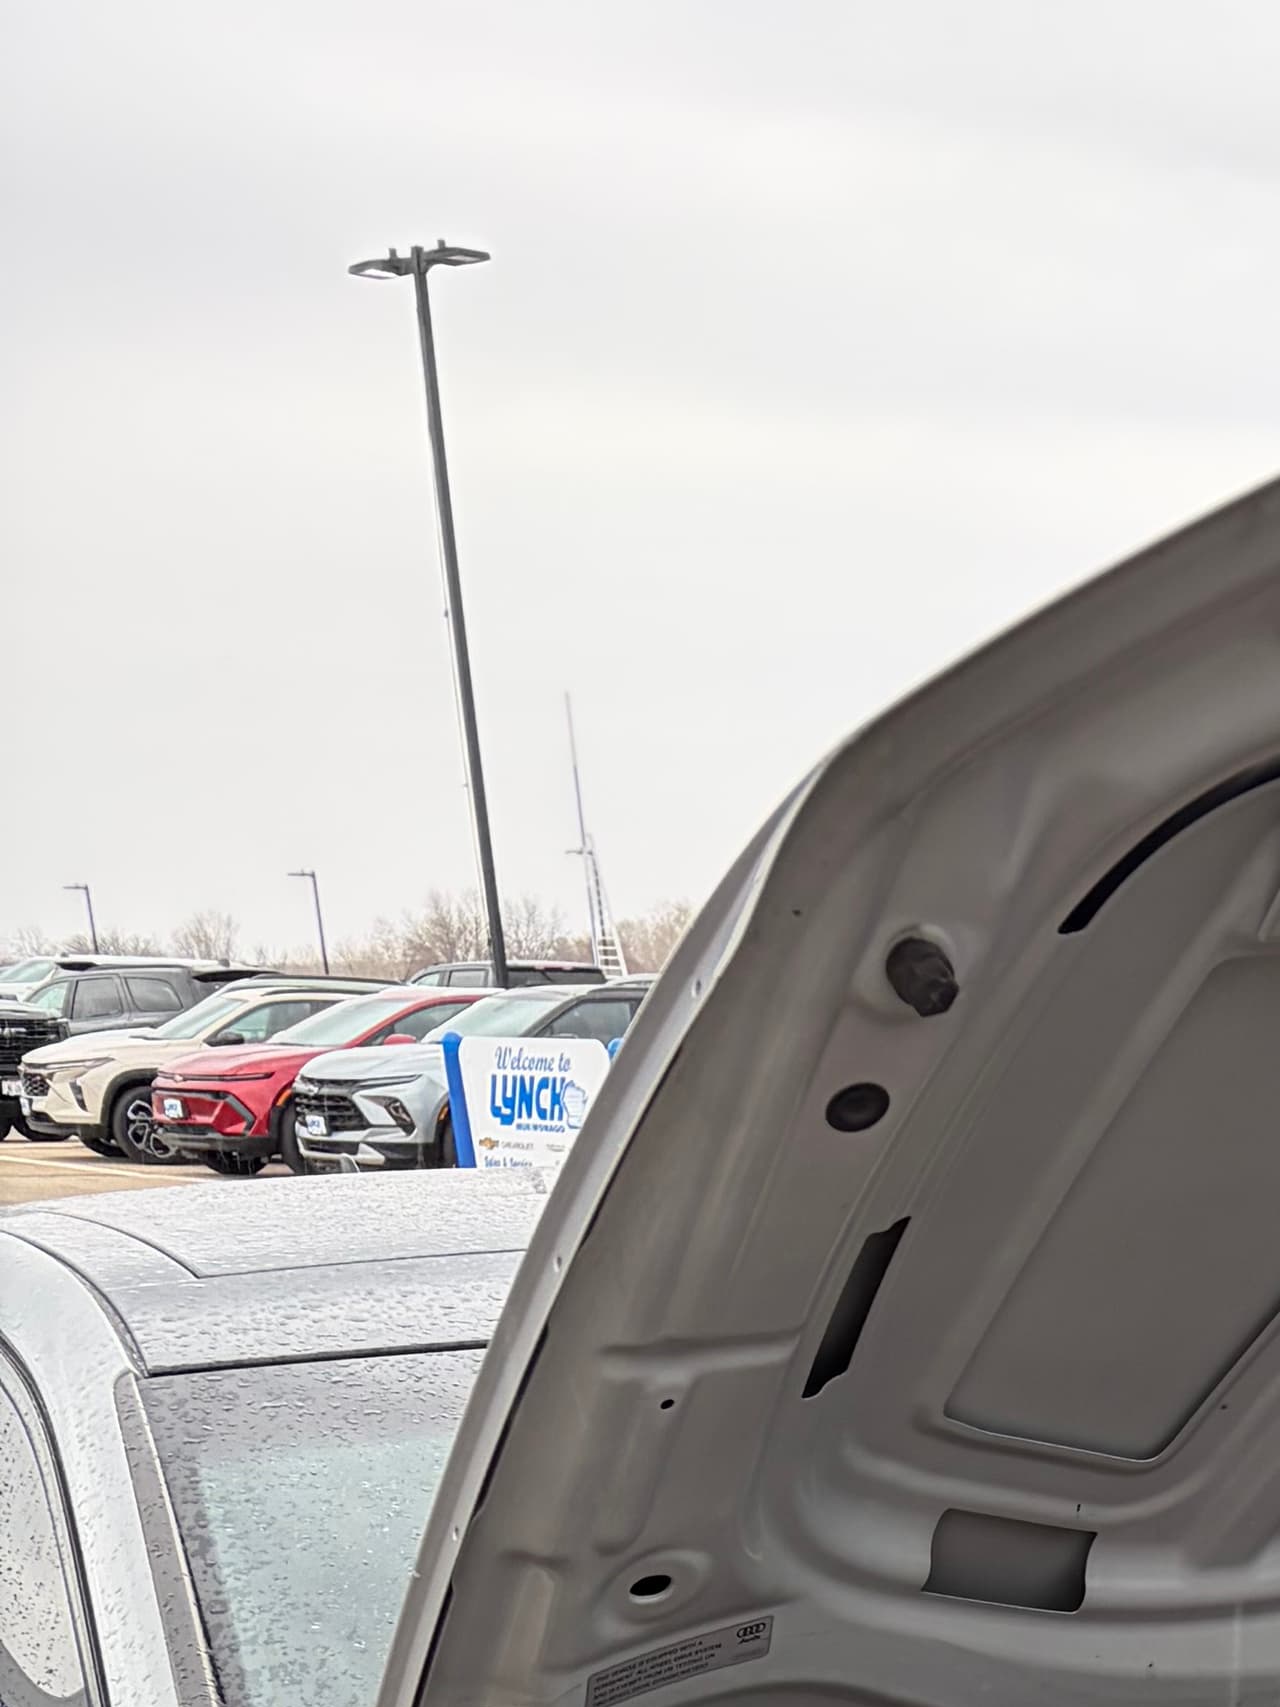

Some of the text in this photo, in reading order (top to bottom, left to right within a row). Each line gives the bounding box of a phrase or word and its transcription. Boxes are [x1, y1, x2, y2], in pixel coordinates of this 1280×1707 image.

[495, 1046, 573, 1072] Welcome to
[490, 1074, 565, 1125] LYNCH
